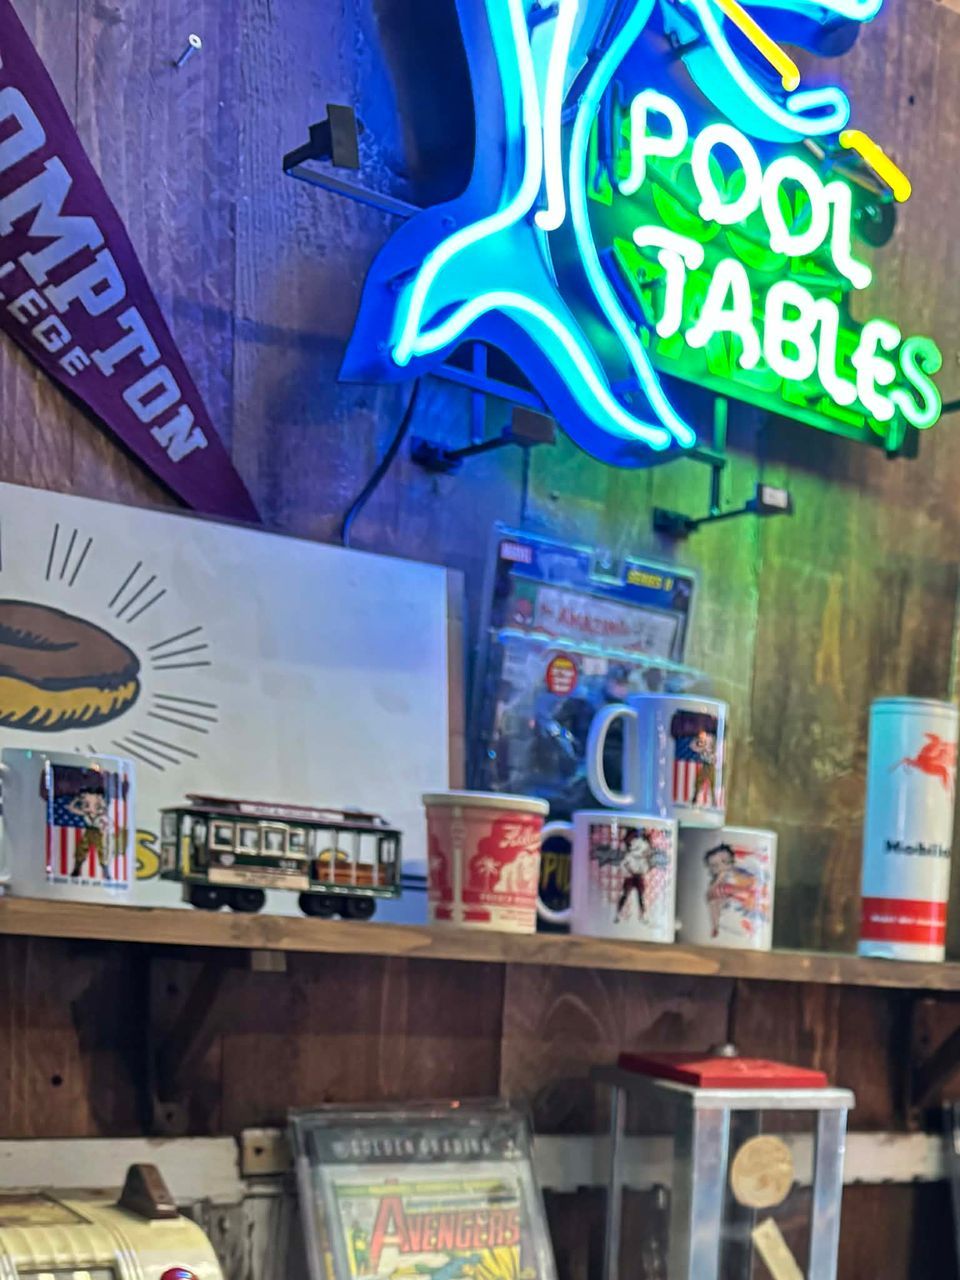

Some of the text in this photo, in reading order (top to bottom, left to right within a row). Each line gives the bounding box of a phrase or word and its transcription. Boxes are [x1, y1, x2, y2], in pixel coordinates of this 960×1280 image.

[619, 89, 872, 289] POOL
[633, 225, 942, 429] TABLES
[368, 1178, 521, 1277] AVENGERS
